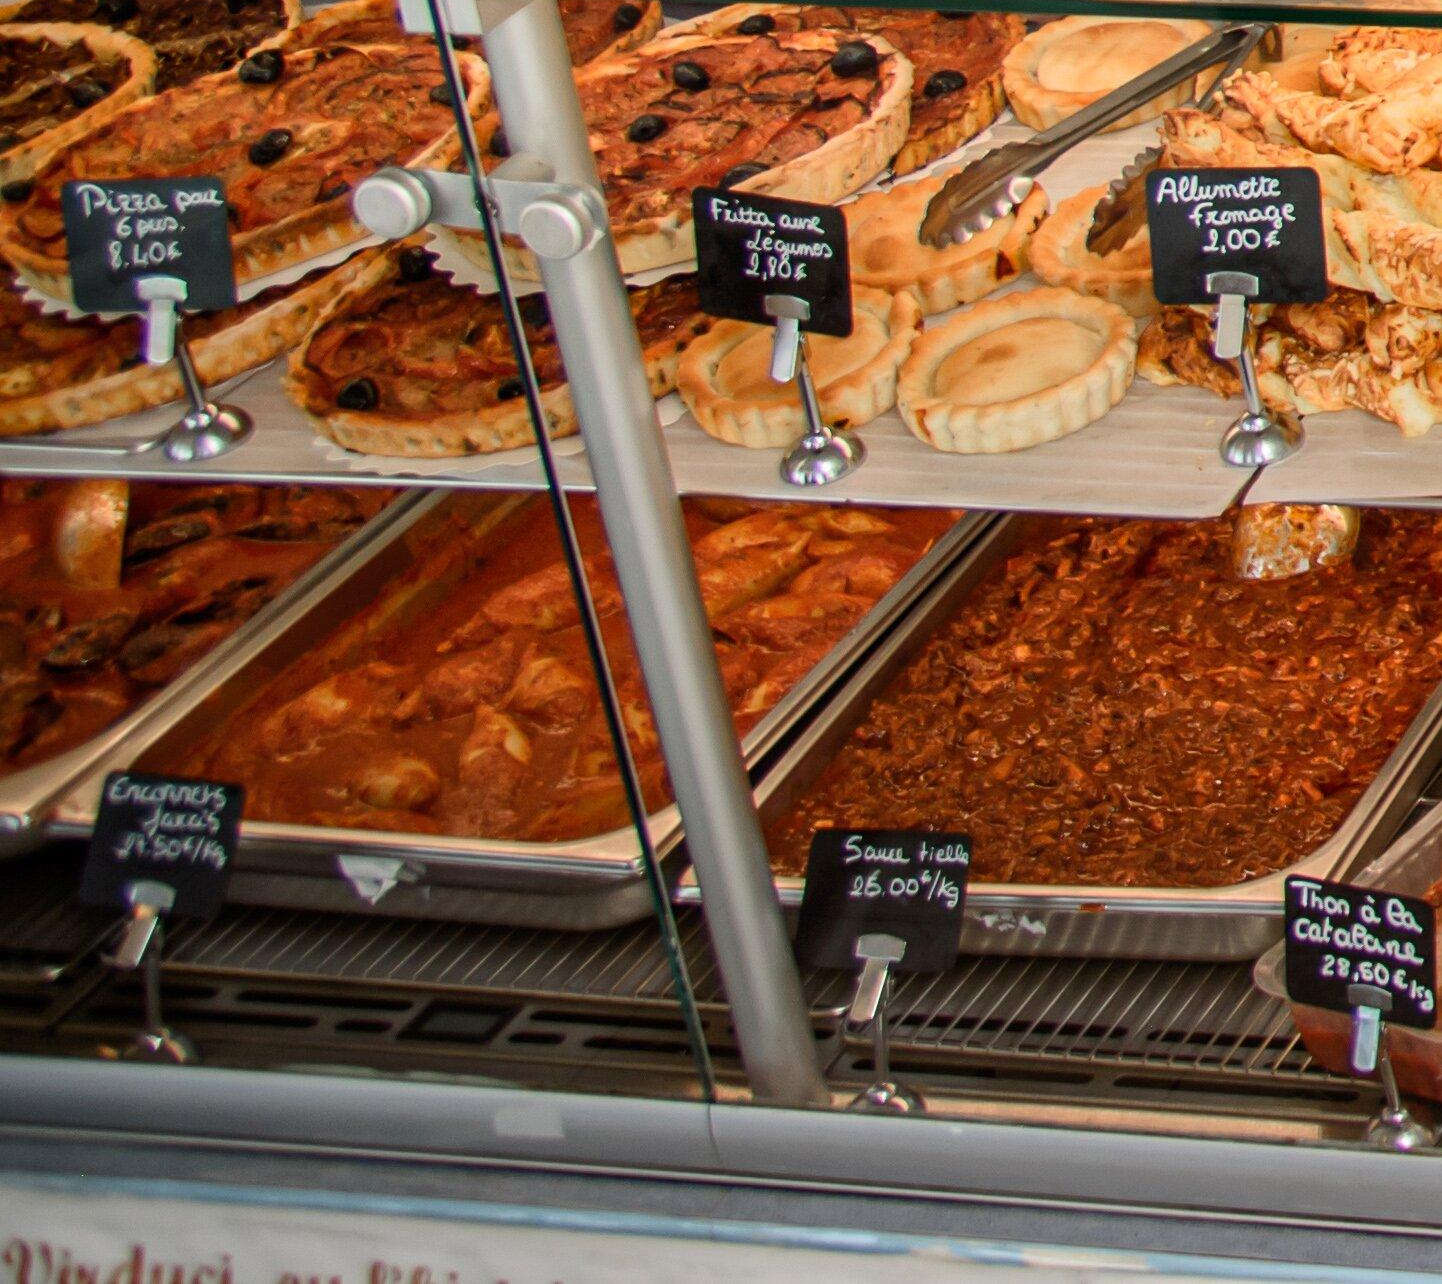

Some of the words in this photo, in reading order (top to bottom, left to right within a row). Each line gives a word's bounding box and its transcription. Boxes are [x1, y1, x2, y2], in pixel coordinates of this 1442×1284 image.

[77, 183, 168, 217] Pizza
[175, 189, 225, 214] pour
[1155, 174, 1283, 206] Allumette
[116, 216, 132, 239] 6
[844, 834, 911, 865] Sauce
[1289, 879, 1350, 917] Thon
[1359, 894, 1382, 926] à
